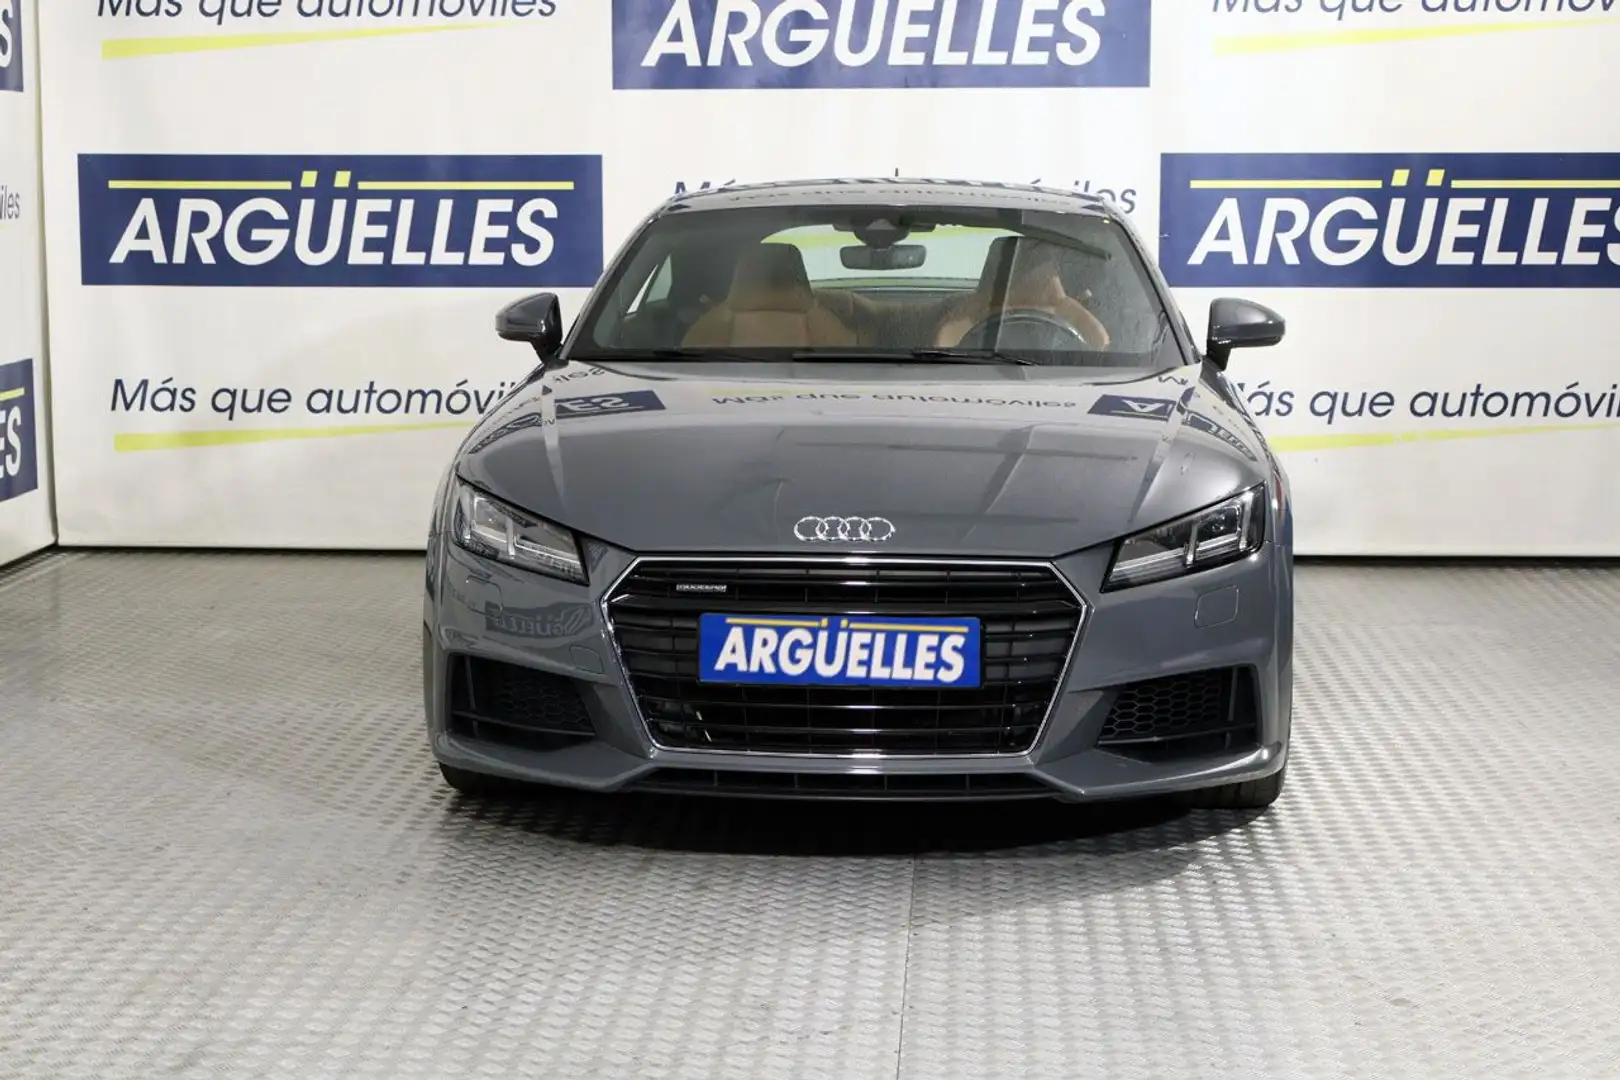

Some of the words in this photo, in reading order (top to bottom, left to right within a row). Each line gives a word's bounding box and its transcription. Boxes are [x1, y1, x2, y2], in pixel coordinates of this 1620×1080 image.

[109, 170, 559, 267] ARGÜELLES
[1187, 169, 1620, 267] ARGÜELLE
[110, 377, 197, 413] Más
[210, 383, 292, 421] que
[1237, 380, 1294, 418] ás
[1309, 391, 1395, 425] que
[714, 617, 966, 683] ARGÜELLES
